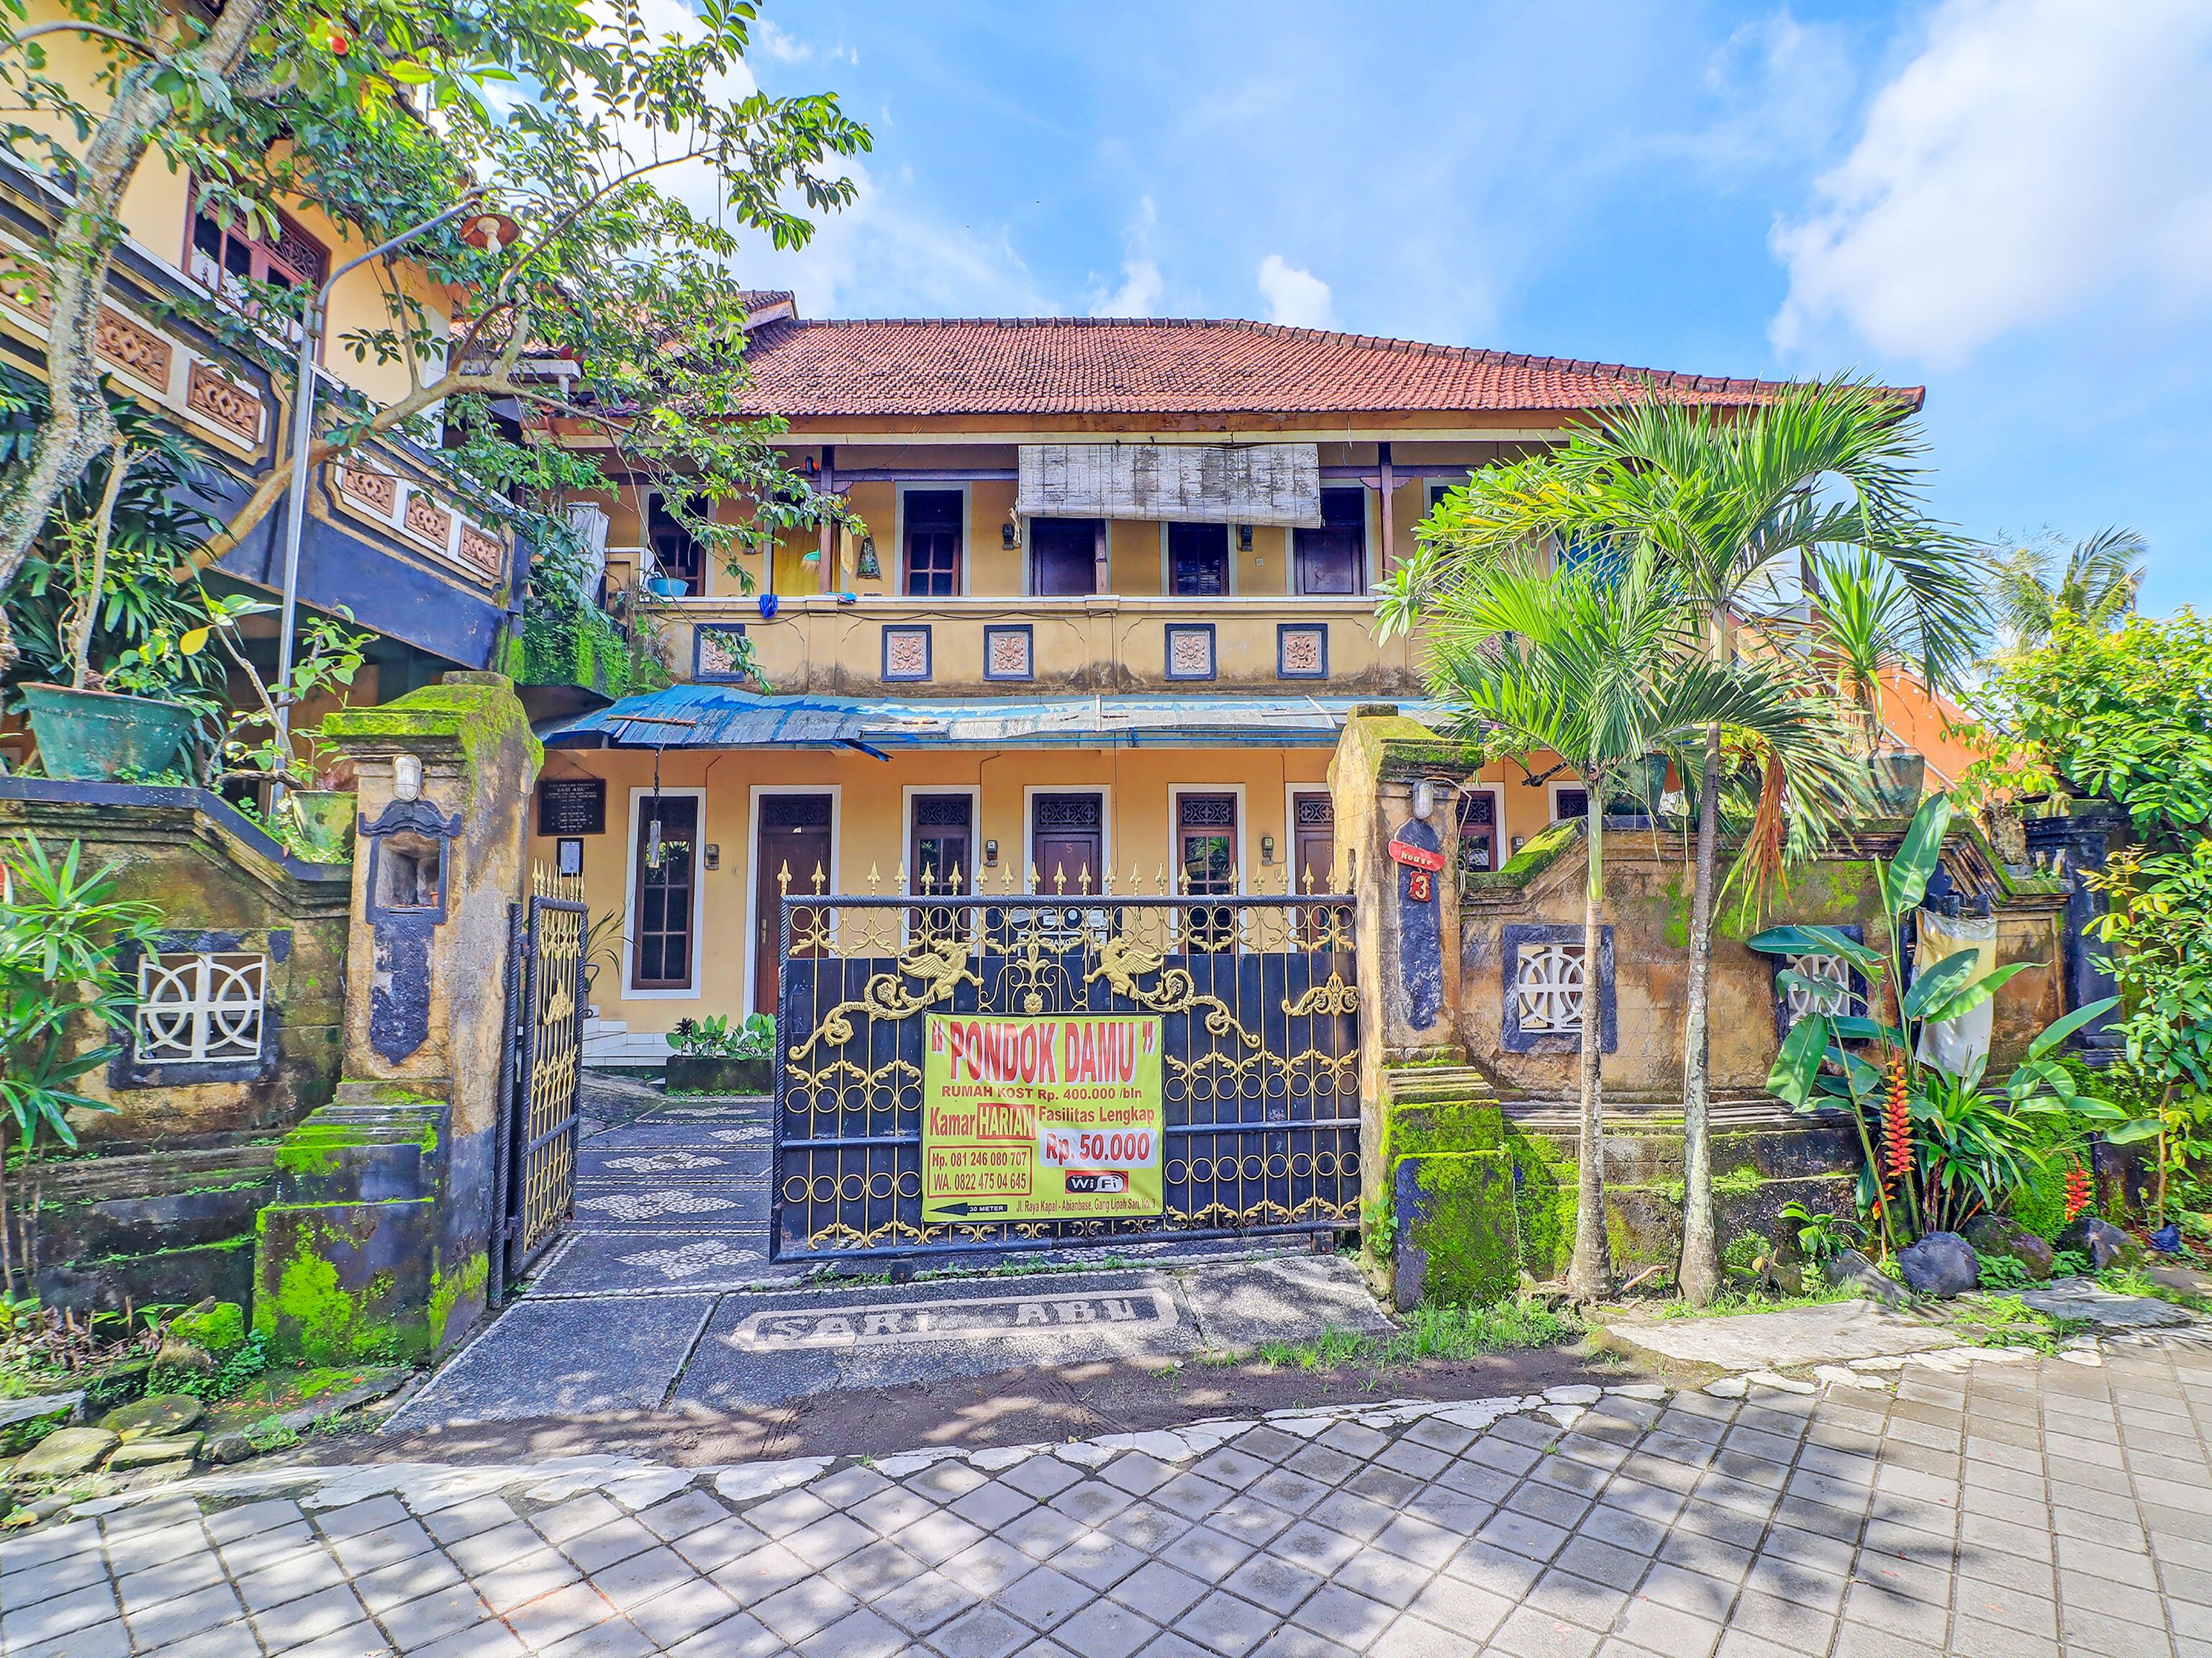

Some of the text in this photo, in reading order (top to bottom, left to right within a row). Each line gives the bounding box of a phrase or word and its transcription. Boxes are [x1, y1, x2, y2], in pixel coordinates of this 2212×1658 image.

[1066, 843, 1072, 853] 5
[1401, 851, 1433, 866] house
[1415, 875, 1427, 899] 3
[950, 1021, 1056, 1084] PONDOK
[1065, 1022, 1134, 1082] DAMU
[941, 1086, 1142, 1102] RUMAH KOST Rp. 400.000 /bln
[930, 1106, 1033, 1137] Kamar HARIAN
[1038, 1105, 1155, 1125] Fasilitas Lengkap
[1046, 1133, 1150, 1166] Rp. 50.000
[932, 1151, 1027, 1170] Hp. 081 246 080 707
[934, 1173, 1027, 1191] WA. 0822 475 04 645
[1025, 1200, 1039, 1215] Raya
[1041, 1200, 1057, 1215] Kapal
[1061, 1199, 1093, 1213] Abianbase,
[1094, 1197, 1110, 1213] Gang
[1110, 1197, 1127, 1213] Lipah
[1128, 1197, 1141, 1211] Sari,
[1152, 1197, 1156, 1209] 3
[1013, 1299, 1139, 1326] ABU
